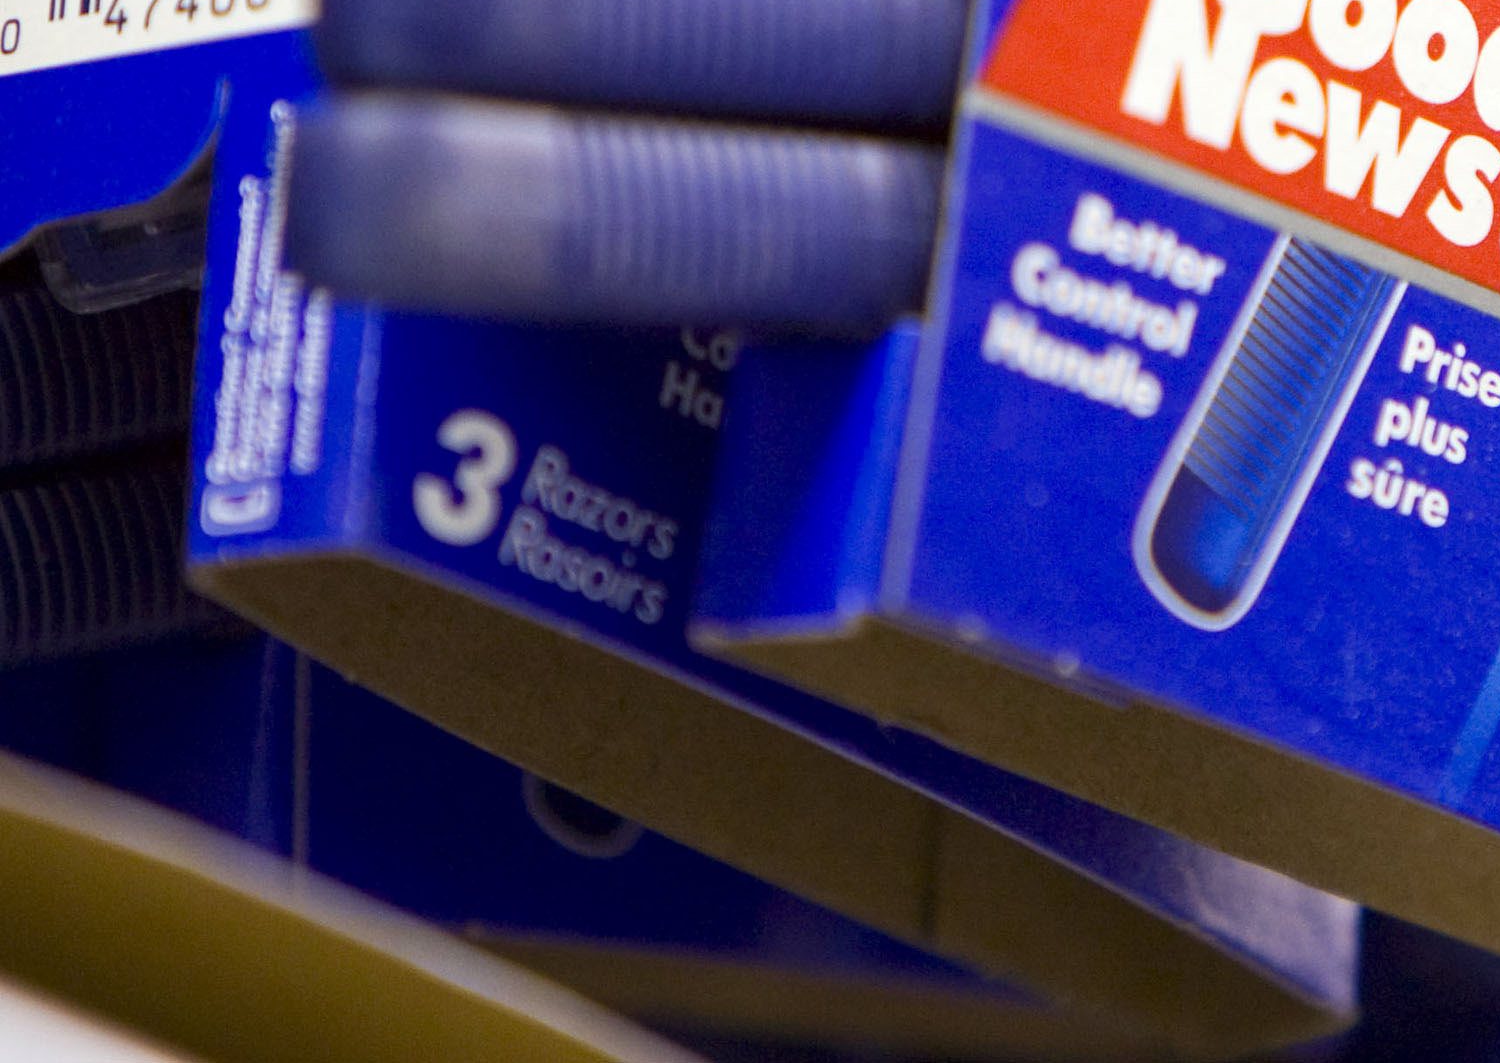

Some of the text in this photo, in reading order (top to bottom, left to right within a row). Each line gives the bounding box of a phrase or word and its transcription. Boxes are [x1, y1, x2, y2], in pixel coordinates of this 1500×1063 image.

[1, 19, 20, 55] 0
[1008, 242, 1198, 358] Control
[1069, 192, 1227, 295] Better
[980, 302, 1163, 418] Handle
[411, 408, 518, 548] 3
[1373, 397, 1470, 465] plus
[521, 443, 680, 561] Razors
[1347, 457, 1451, 530] sûre
[497, 503, 669, 626] Rasoirs
